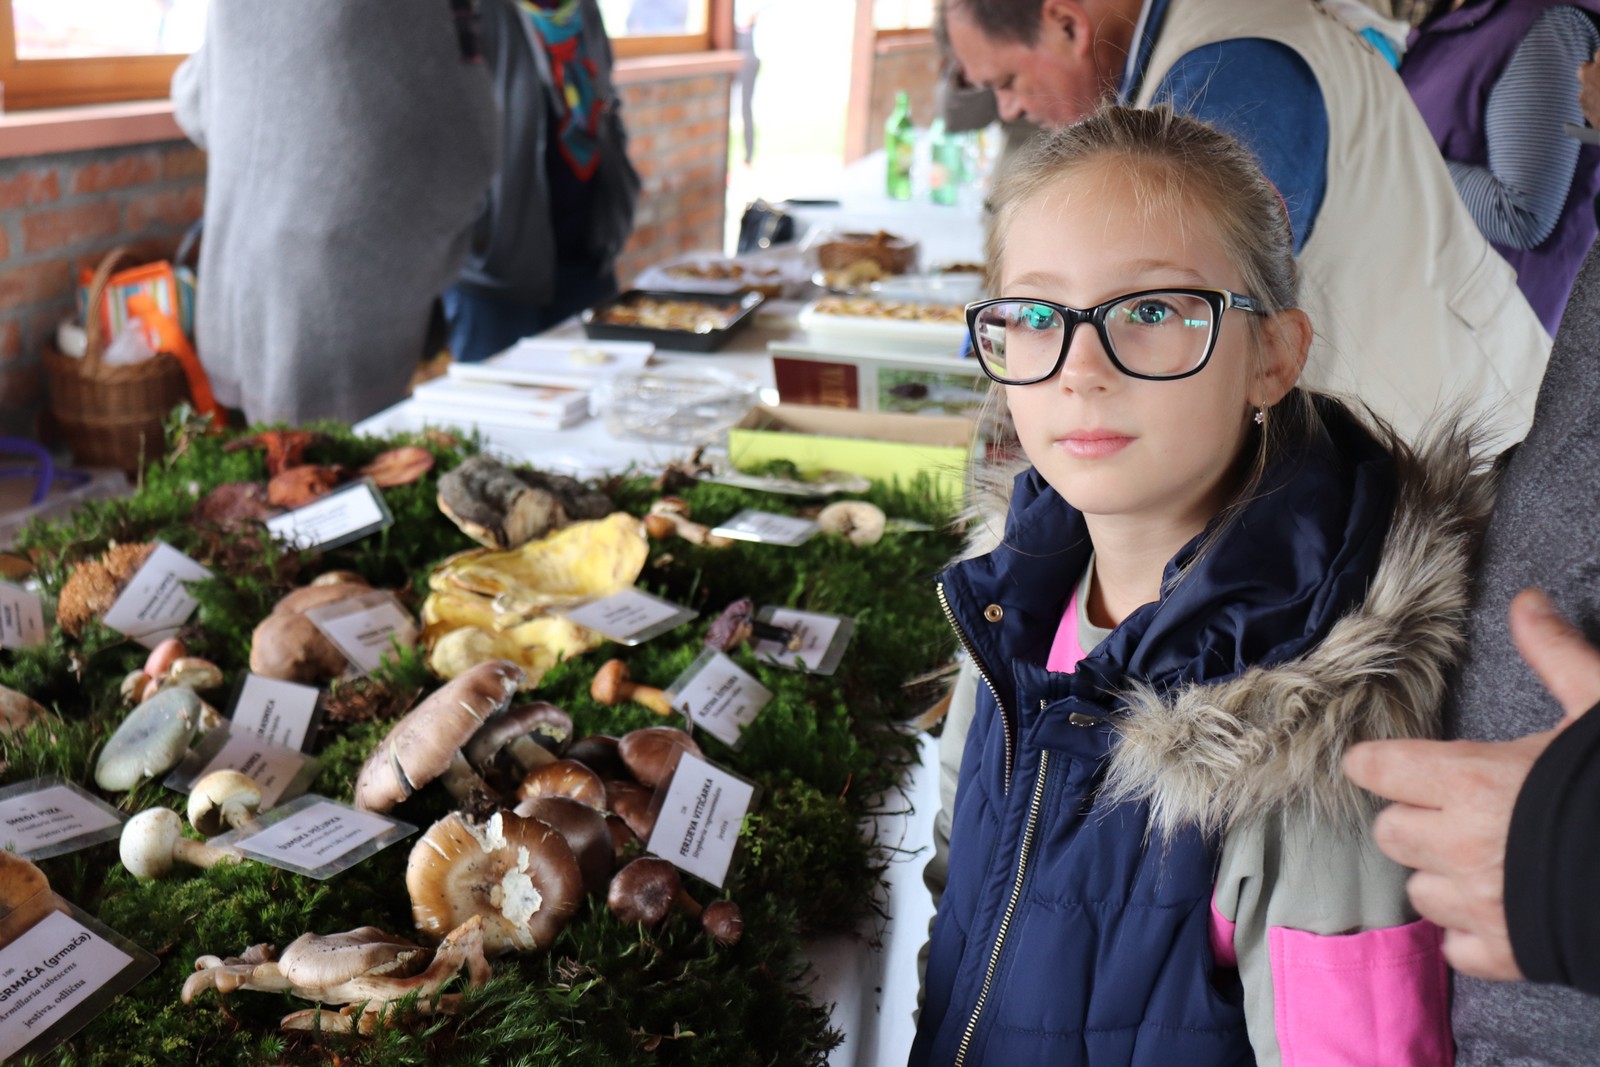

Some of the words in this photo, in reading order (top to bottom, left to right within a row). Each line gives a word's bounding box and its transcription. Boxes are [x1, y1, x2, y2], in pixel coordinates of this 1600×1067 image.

[679, 820, 699, 857] FERIJEVA
[692, 778, 713, 819] VITIČARKA
[43, 931, 92, 969] (grmača)
[0, 988, 41, 1021] Armillaria
[40, 961, 78, 990] tabescens
[22, 1002, 56, 1029] jestiva,
